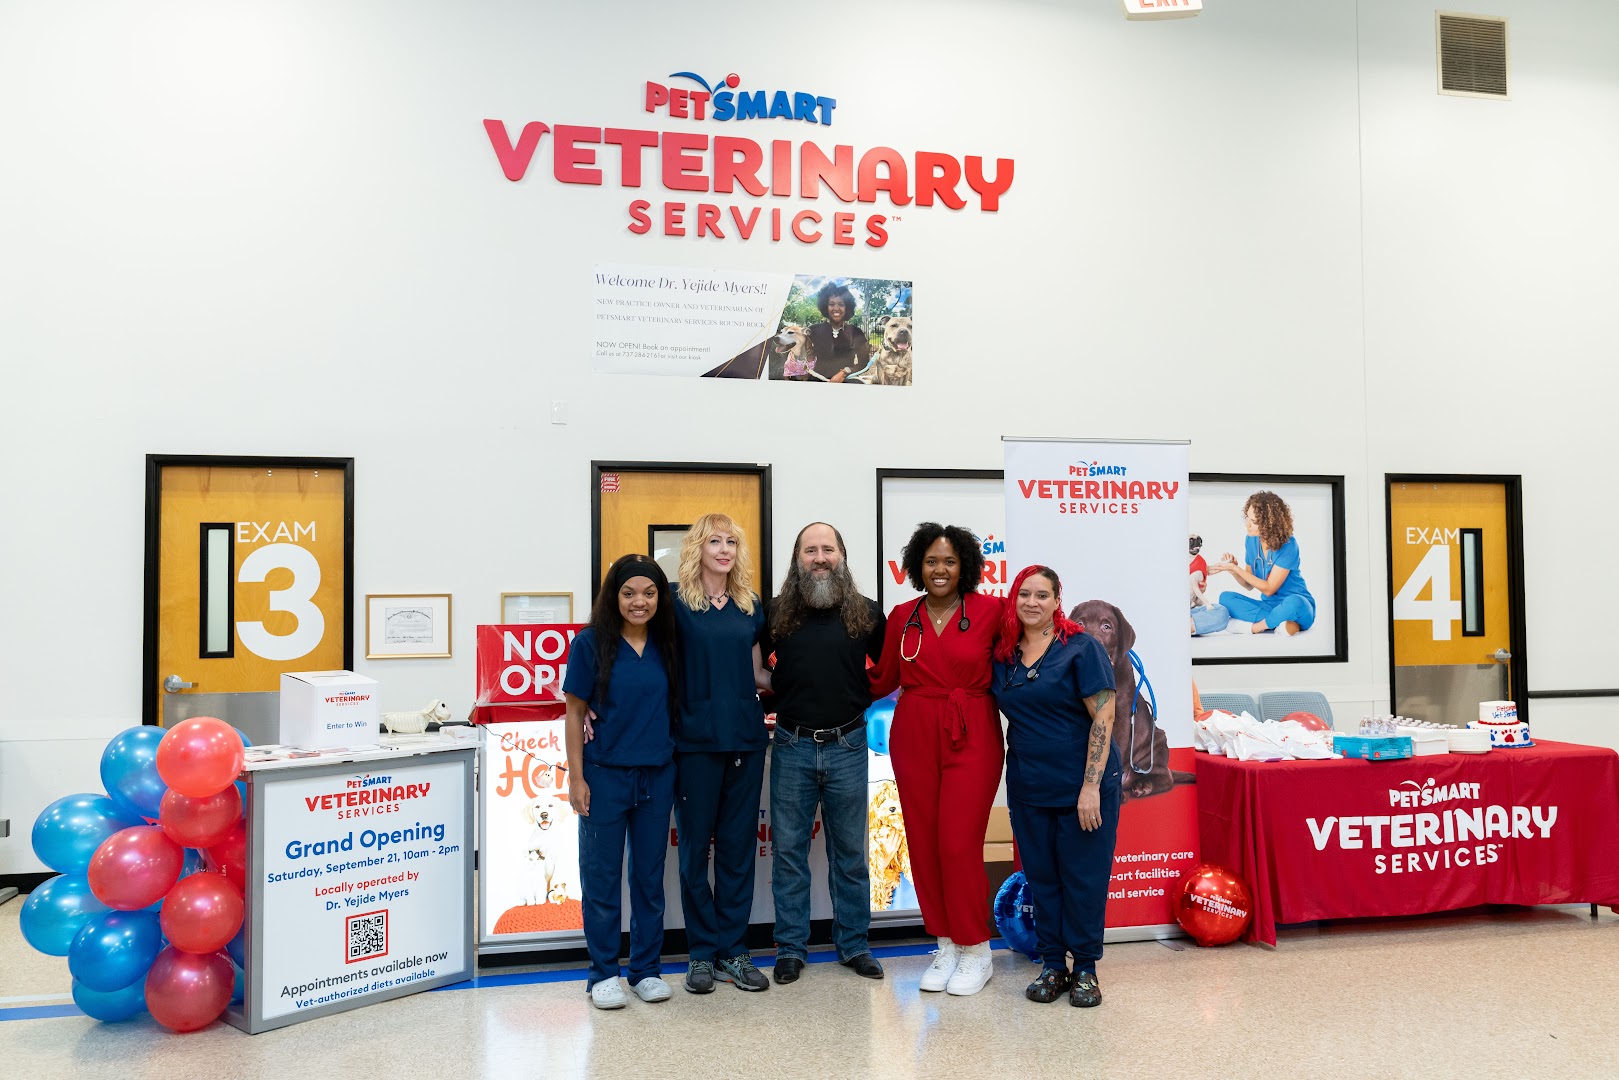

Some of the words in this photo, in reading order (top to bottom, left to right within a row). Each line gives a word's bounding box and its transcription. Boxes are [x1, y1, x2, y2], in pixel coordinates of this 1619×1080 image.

[645, 79, 837, 127] PETSMART
[482, 118, 1015, 212] VETERINARY
[627, 199, 889, 248] SERVICES
[595, 273, 656, 289] Welcome
[658, 277, 678, 290] Dr.
[682, 278, 720, 294] Yejide
[722, 281, 768, 296] Myers!!
[615, 299, 652, 307] PRACTICE
[653, 301, 680, 309] OWNER
[700, 304, 753, 313] VETERINARIAN
[596, 313, 636, 322] PETSMART
[637, 315, 682, 324] VETERINARY
[684, 318, 718, 326] SERVICES
[618, 342, 641, 350] OPEN!
[642, 343, 658, 351] Book
[670, 345, 711, 353] appointment!
[1069, 464, 1127, 477] PETSMART
[1017, 479, 1179, 500] VETERINARY
[1059, 502, 1139, 514] SERVICES
[237, 520, 316, 543] EXAM
[1406, 527, 1460, 545] EXAM
[235, 542, 325, 661] 3
[1392, 544, 1462, 640] 4
[503, 629, 577, 662] NO
[500, 663, 567, 696] OP
[324, 694, 371, 704] VETERINARY
[326, 722, 345, 730] Enter
[354, 720, 368, 728] Win
[500, 729, 561, 752] Check
[346, 775, 392, 789] PETSMART
[304, 782, 431, 812] VETERINARY
[1388, 780, 1481, 809] PETSMART
[337, 803, 400, 820] SERVICES
[1305, 803, 1558, 851] VETERINARY
[285, 831, 353, 860] Grand
[359, 821, 445, 851] Opening
[267, 866, 323, 883] Saturday,
[325, 855, 385, 875] September
[387, 853, 401, 864] 21,
[403, 848, 430, 861] 10am
[438, 844, 460, 857] 2pm
[1114, 851, 1170, 863] veterinary
[1171, 851, 1194, 860] care
[1374, 842, 1499, 875] SERVICES
[315, 881, 354, 897] Locally
[356, 872, 405, 893] operated
[407, 870, 420, 883] by
[1135, 867, 1180, 880] facilities
[325, 900, 341, 911] Dr.
[344, 893, 376, 909] Yejide
[378, 887, 409, 901] Myers
[1127, 886, 1165, 898] service
[1190, 893, 1248, 918] VETERINARY
[1202, 905, 1233, 920] SERVICES
[280, 967, 369, 998] Appointments
[371, 954, 423, 977] available
[425, 950, 448, 964] now
[295, 983, 369, 1009] Vet-authorized
[371, 978, 394, 990] diets
[395, 968, 436, 985] available
